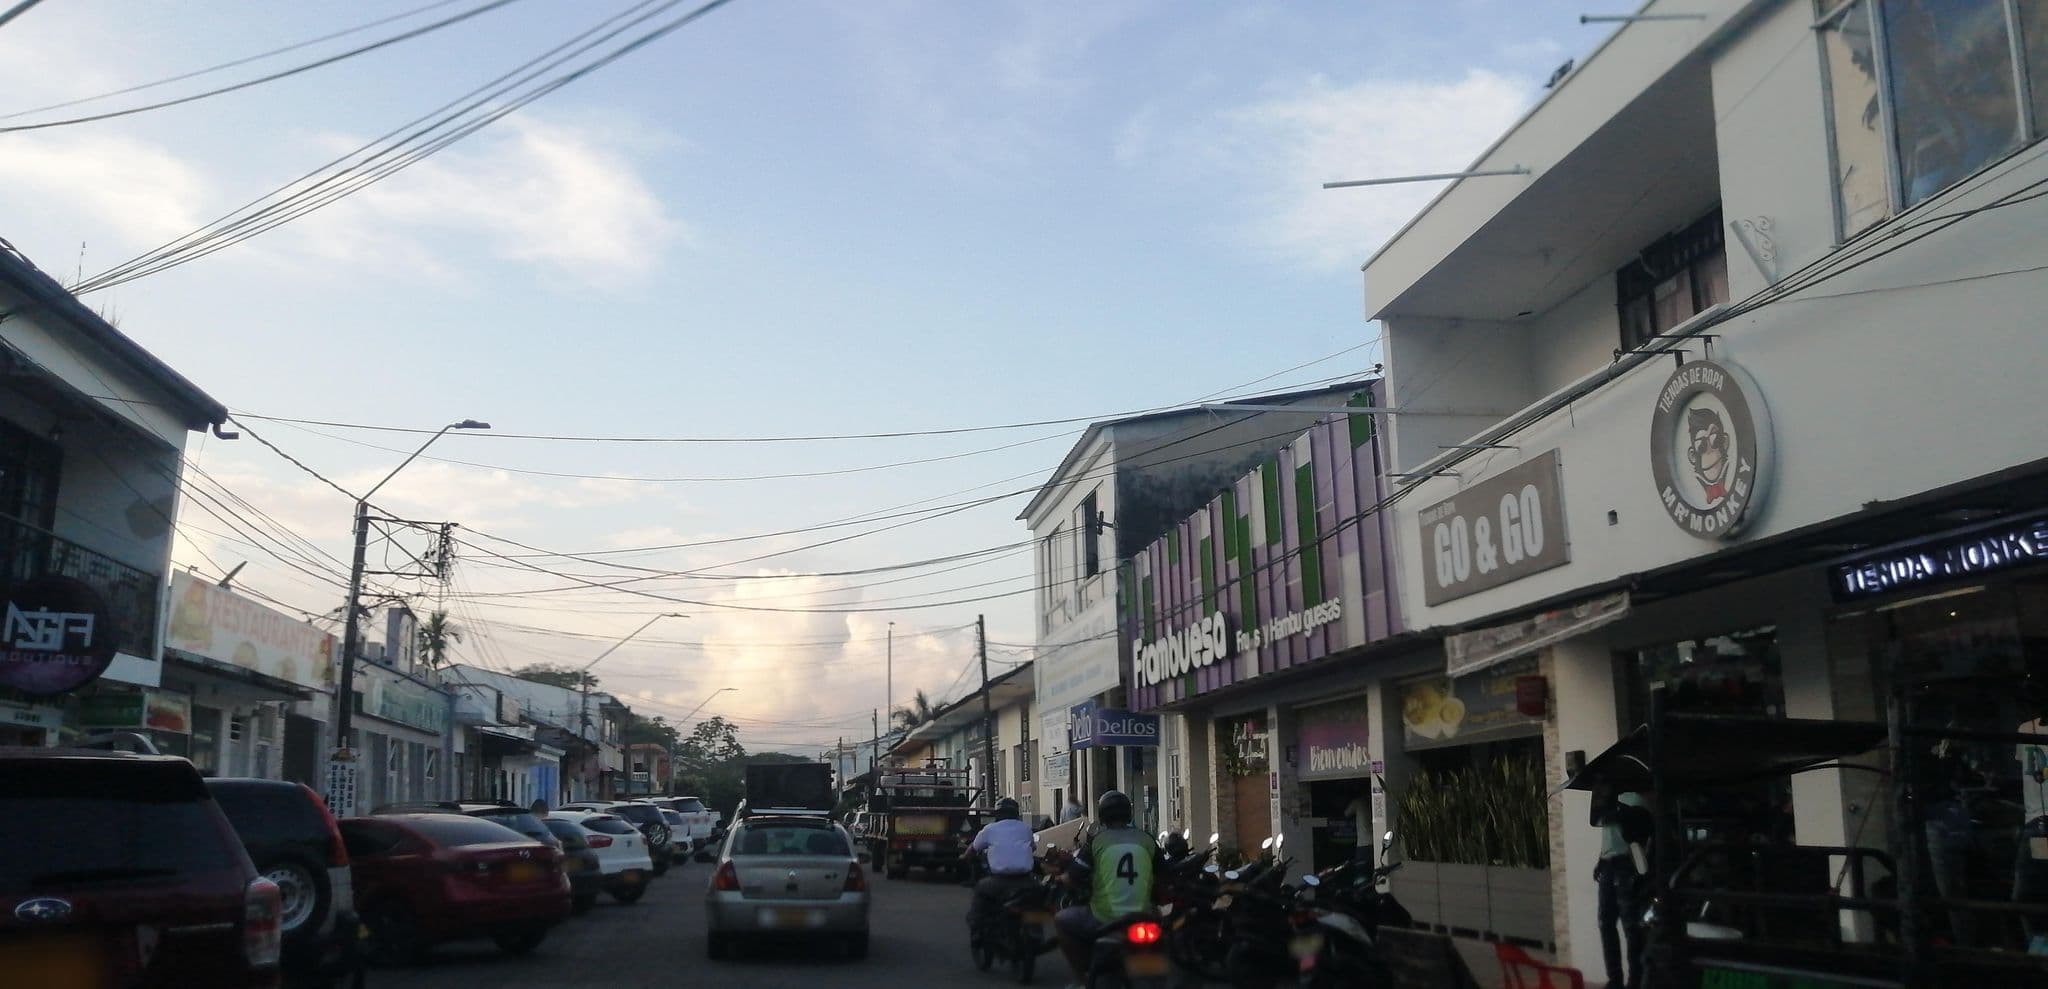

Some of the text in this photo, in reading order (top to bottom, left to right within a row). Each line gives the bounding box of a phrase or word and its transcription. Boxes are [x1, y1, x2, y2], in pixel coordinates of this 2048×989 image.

[1658, 367, 1724, 413] TIENDAS DE ROPA
[1433, 483, 1545, 589] GO & GO
[1133, 610, 1228, 689] Frambuesa
[1096, 717, 1156, 735] Delfos
[1116, 852, 1138, 885] 4
